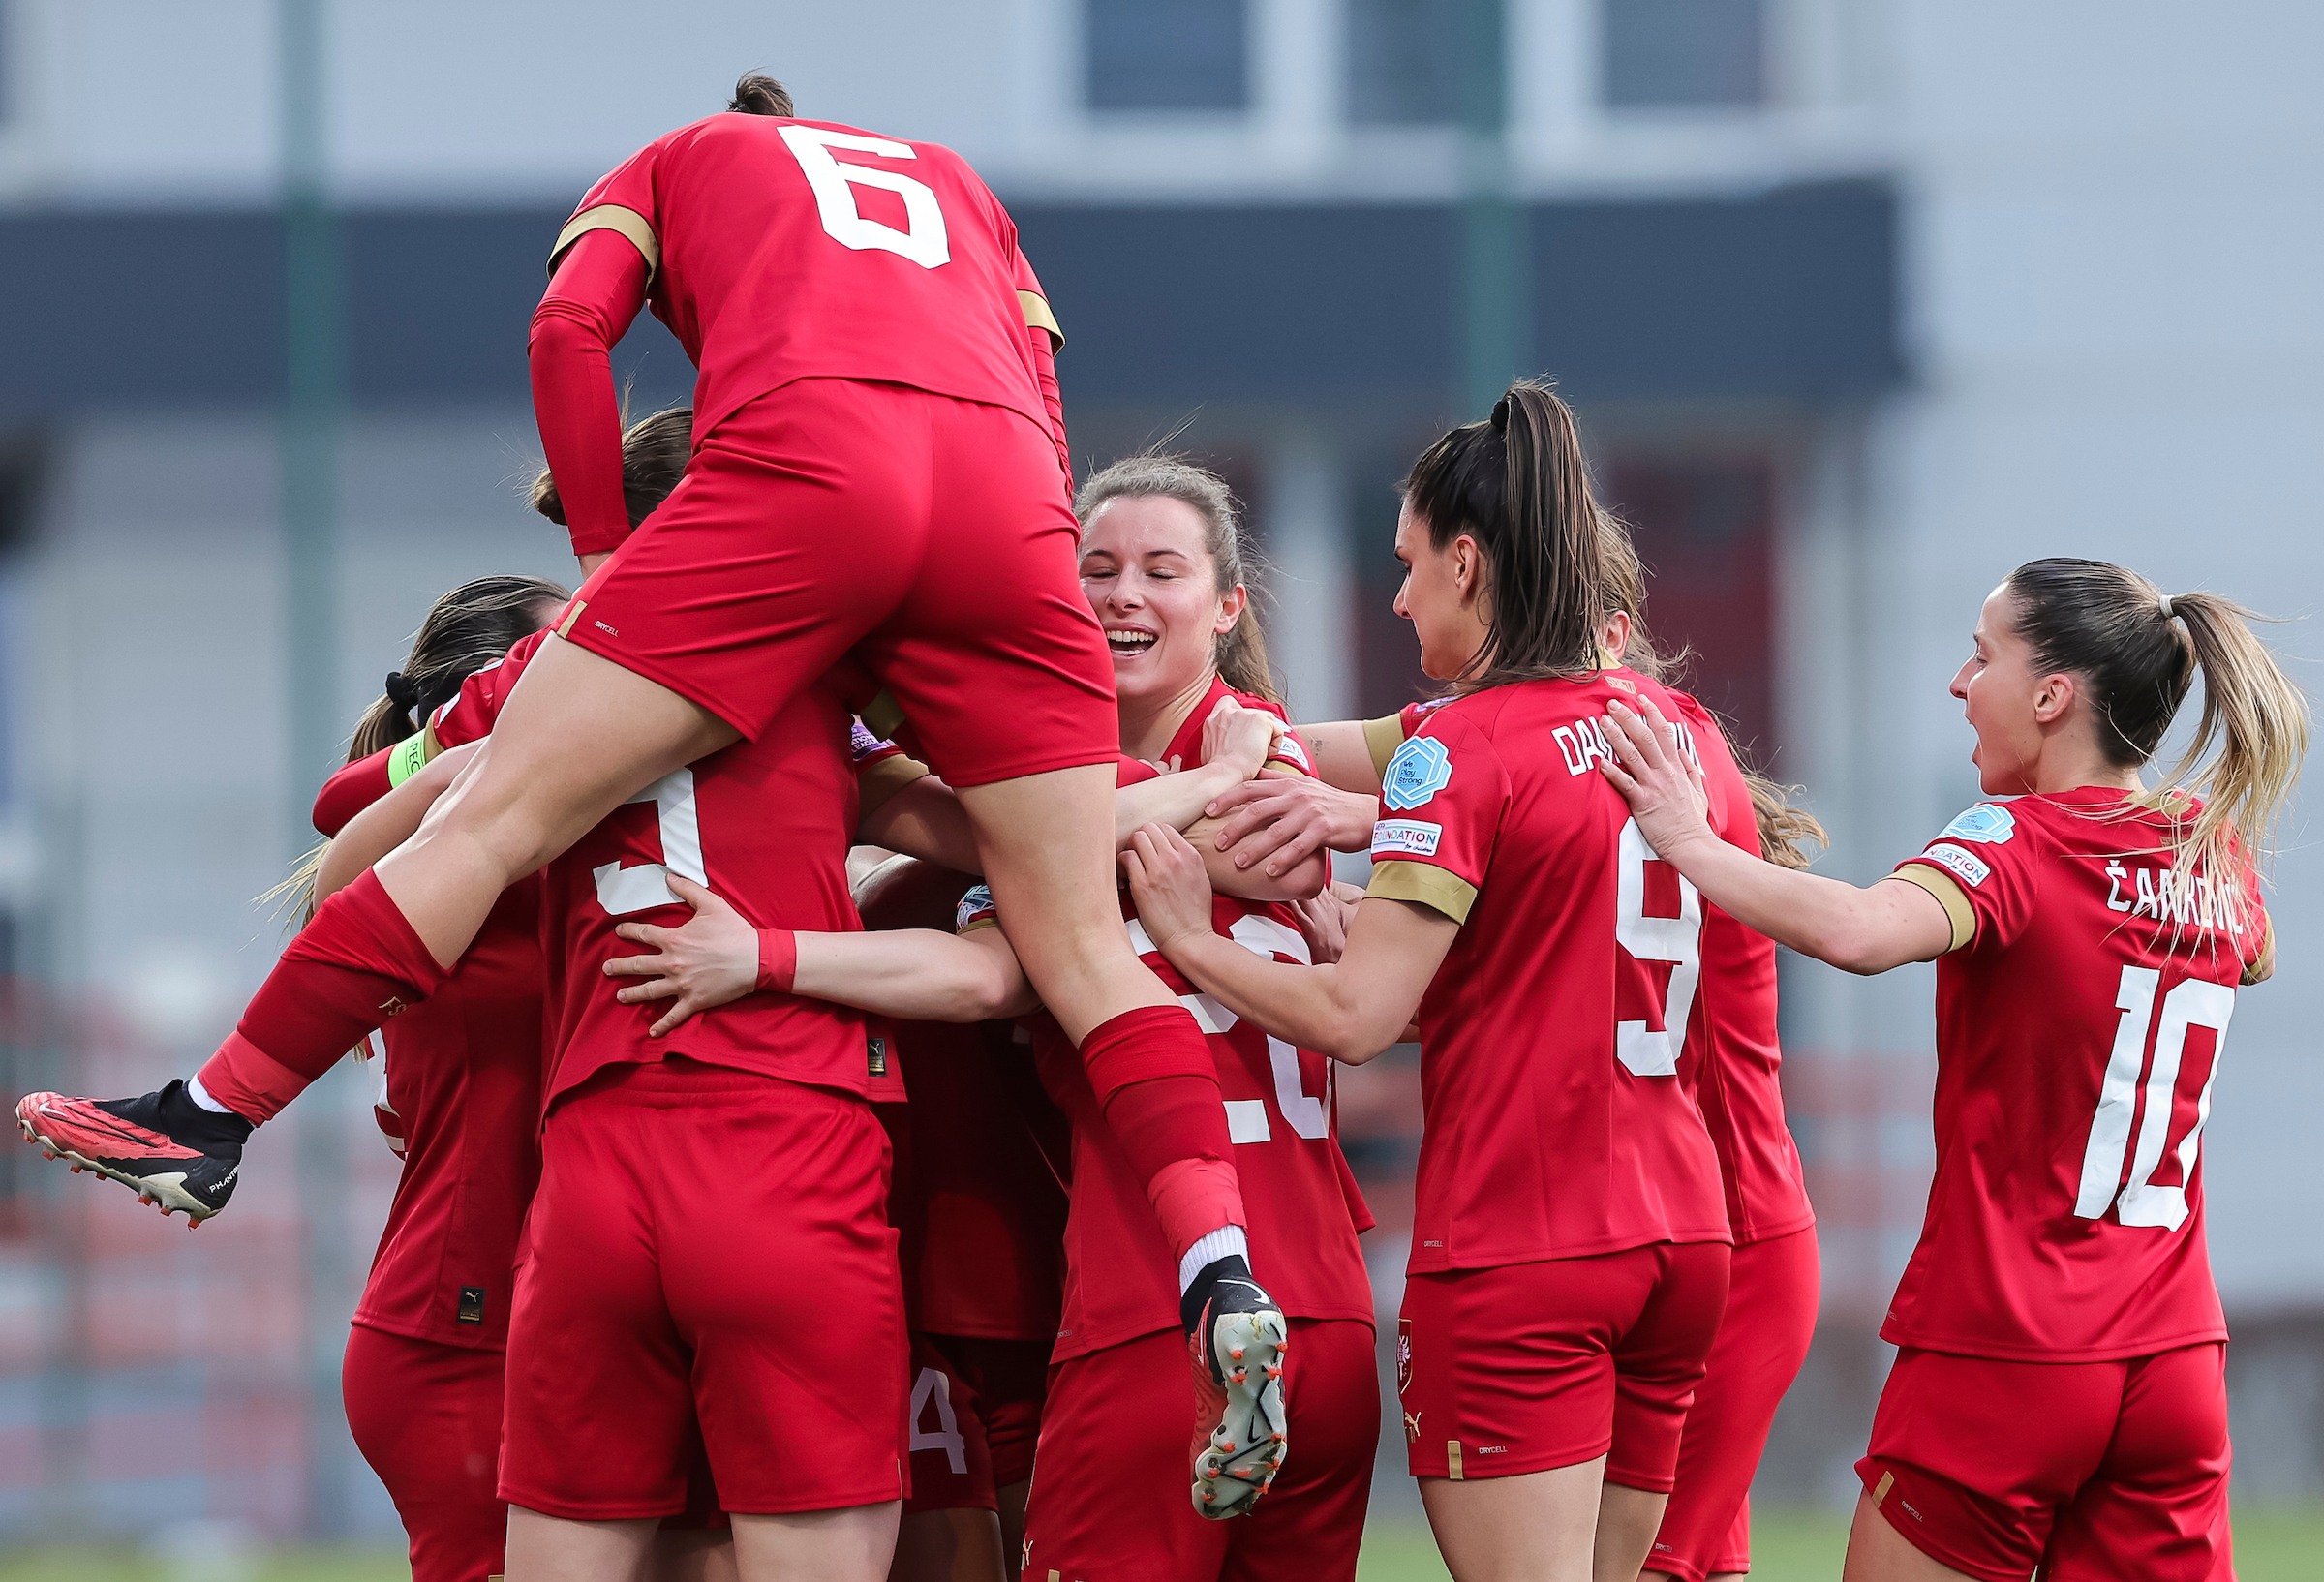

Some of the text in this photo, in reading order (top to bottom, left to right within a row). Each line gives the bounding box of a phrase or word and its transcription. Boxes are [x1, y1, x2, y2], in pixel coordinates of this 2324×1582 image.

[776, 125, 952, 270] 6
[1615, 816, 1702, 1077] 9
[2073, 964, 2236, 1232] 10
[1479, 1445, 1508, 1454] DRYCELL
